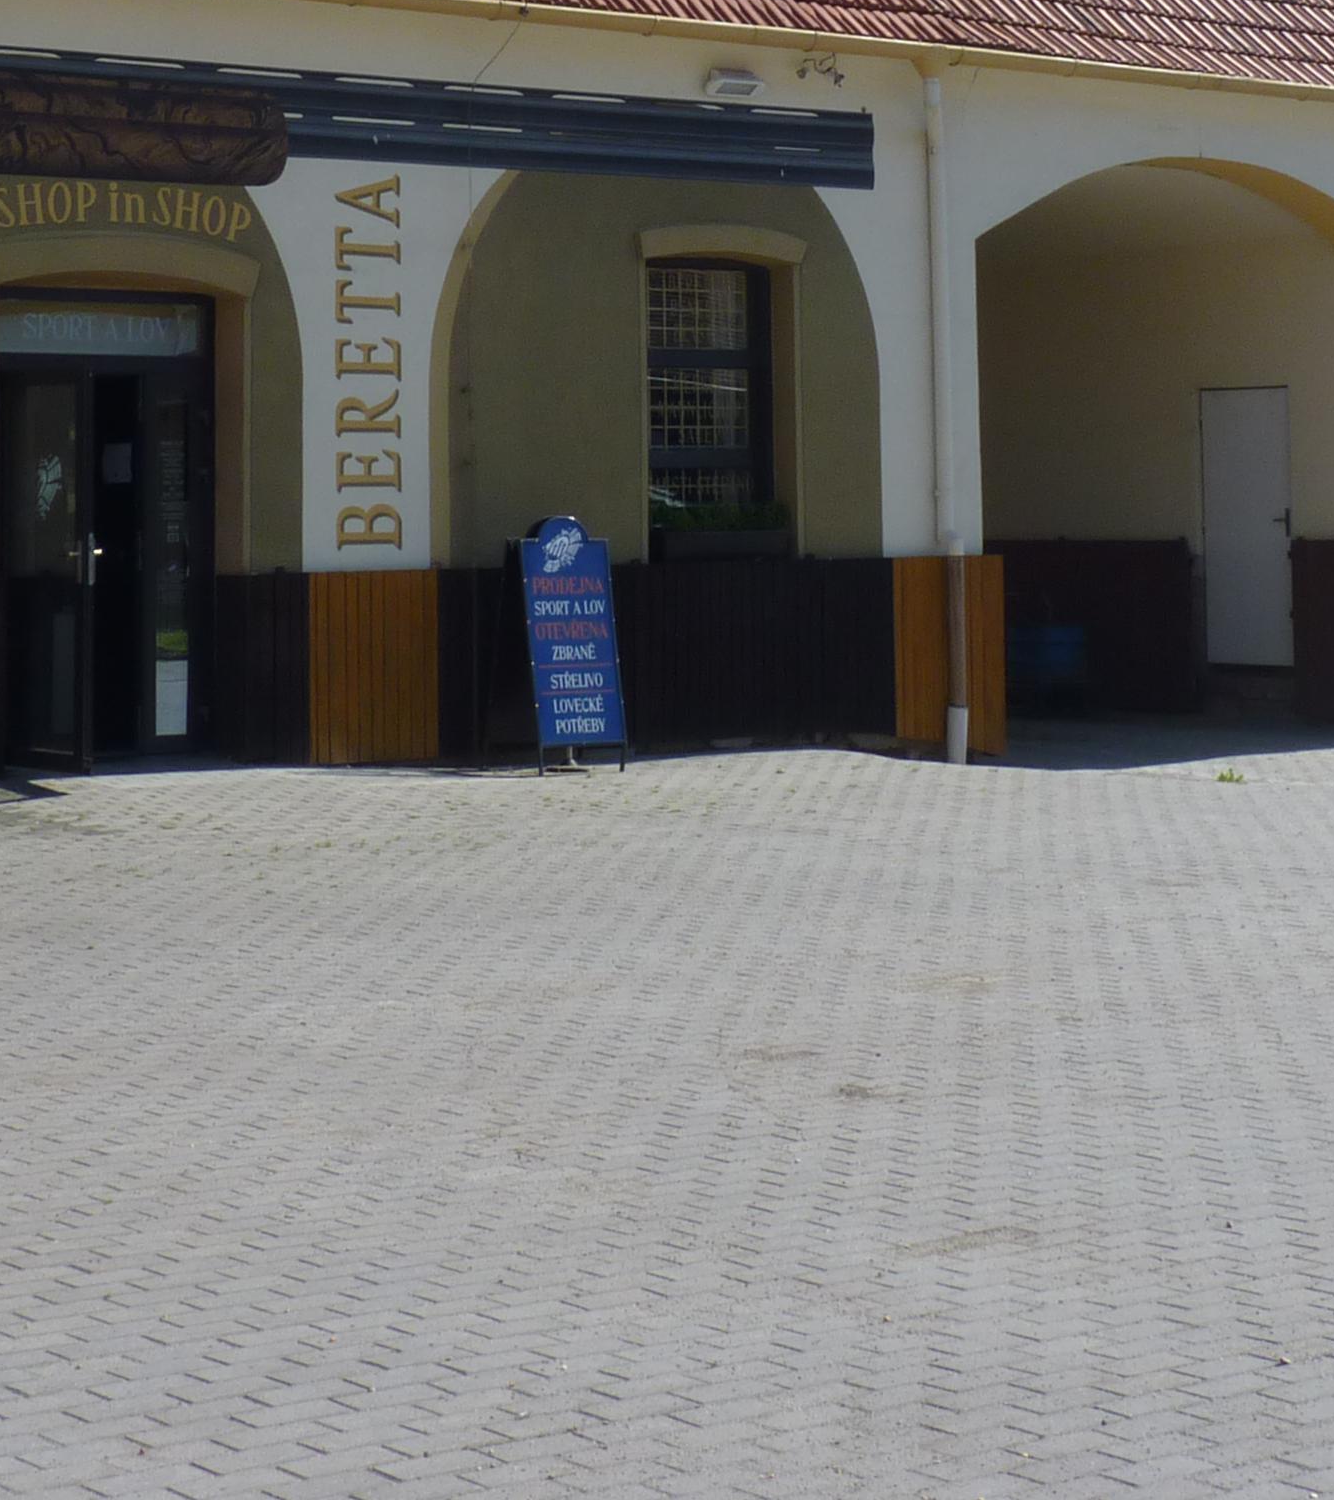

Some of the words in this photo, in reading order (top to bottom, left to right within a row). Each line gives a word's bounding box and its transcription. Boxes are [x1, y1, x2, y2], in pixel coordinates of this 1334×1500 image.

[109, 181, 145, 224] in
[152, 187, 252, 242] SHOP
[23, 312, 93, 341] SPORT
[105, 318, 118, 341] A
[127, 316, 170, 341] LOV
[334, 174, 402, 551] BERETTA
[531, 576, 604, 596] PRODEJNA
[534, 600, 570, 617] SPORT
[573, 601, 581, 616] A
[584, 599, 606, 615] LOV
[535, 620, 609, 641] OTEVŘENA
[552, 642, 596, 661] ZBRANĚ
[550, 671, 604, 690] STŘELIVO
[553, 694, 604, 714] LOVECKÉ
[555, 715, 606, 735] POTŘEBY
